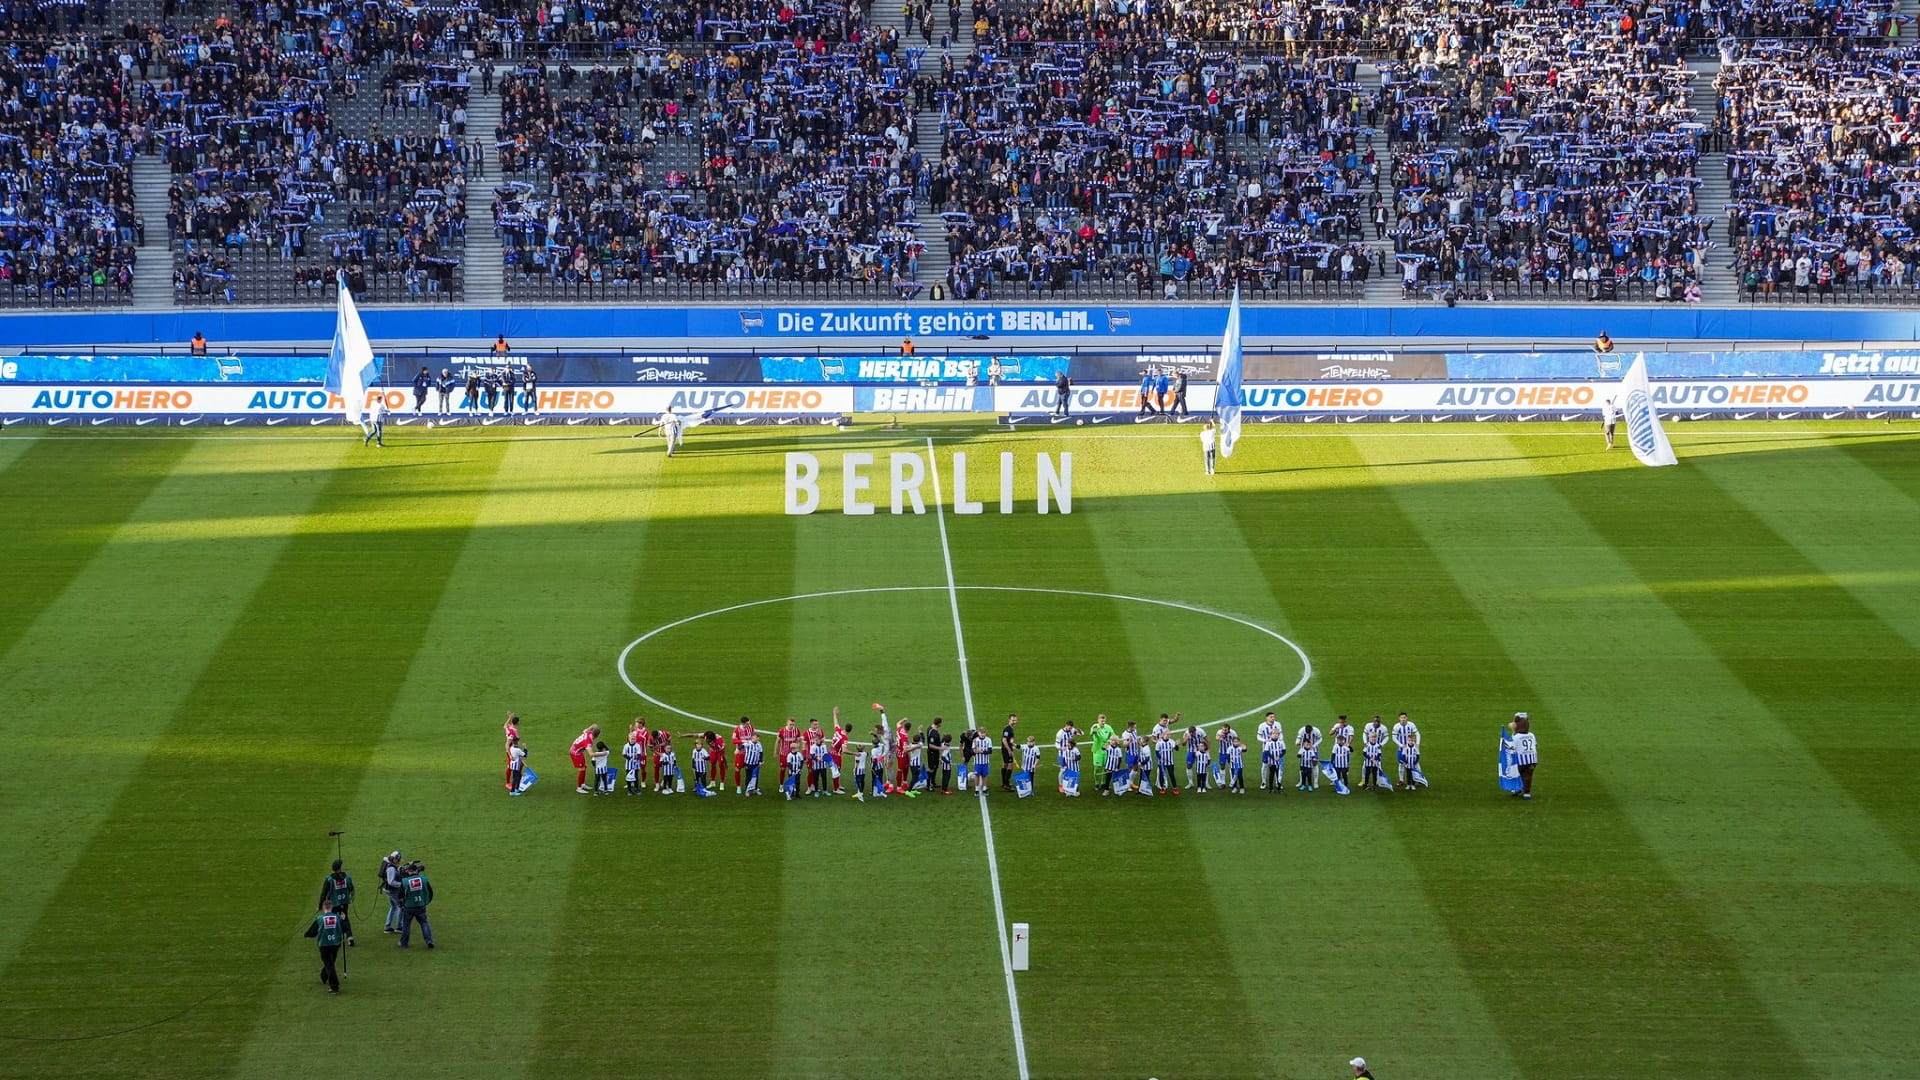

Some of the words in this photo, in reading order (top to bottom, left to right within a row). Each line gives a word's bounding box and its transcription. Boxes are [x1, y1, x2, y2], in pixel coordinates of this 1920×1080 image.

[778, 312, 814, 332] Die
[821, 311, 911, 332] Zukunft
[918, 310, 995, 335] gehört
[858, 360, 940, 378] HERTHA
[1820, 353, 1882, 373] Jetzt
[1884, 354, 1920, 375] au
[32, 390, 193, 409] AUTOHERO
[248, 390, 405, 409] AUTOHRO
[459, 391, 614, 409] AUOHERO
[670, 390, 822, 409] AUTOHERO
[1436, 386, 1595, 405] AUTOHERO
[1651, 385, 1809, 404] AUTOHERO
[785, 452, 1072, 515] BERLIN
[1522, 739, 1532, 750] 92
